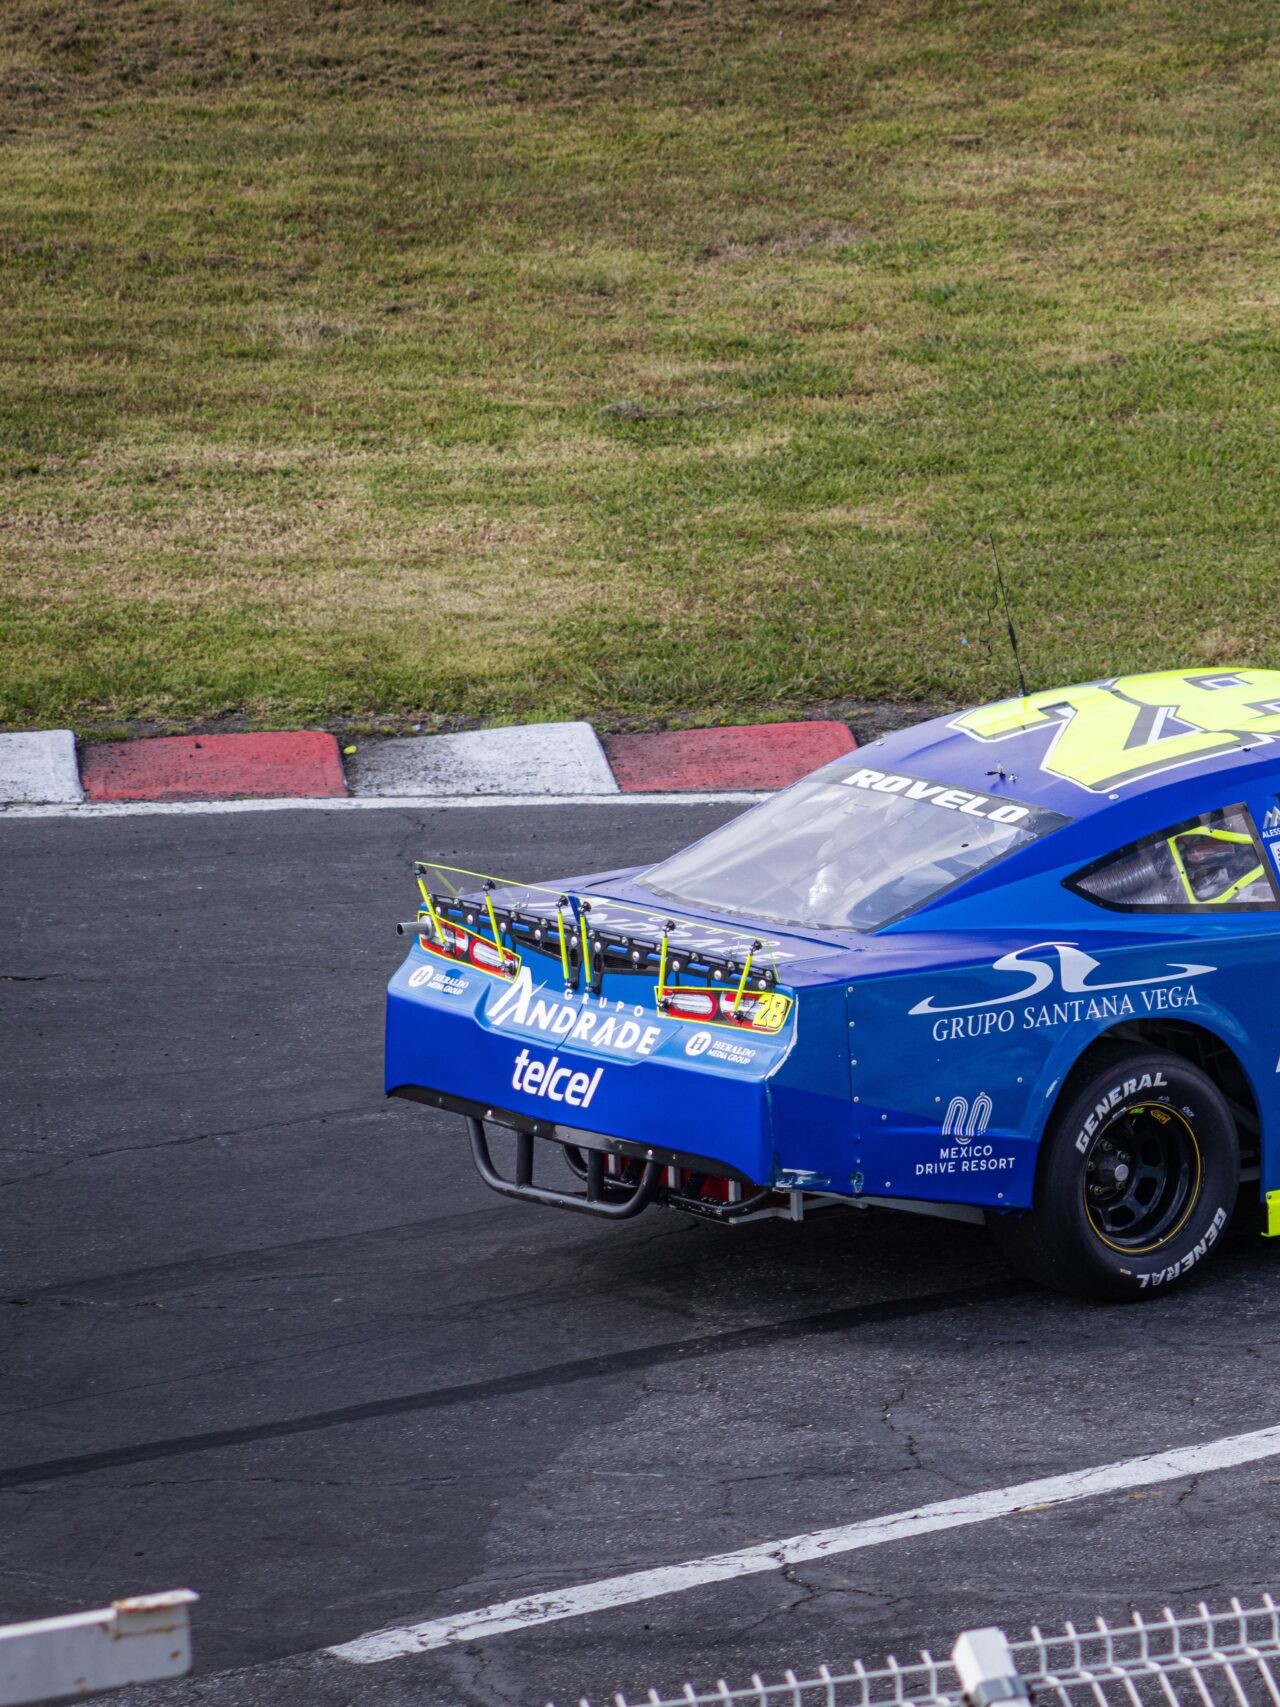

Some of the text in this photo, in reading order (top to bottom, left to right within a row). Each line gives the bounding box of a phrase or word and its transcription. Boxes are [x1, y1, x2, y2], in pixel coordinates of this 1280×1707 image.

[841, 768, 1030, 823] ROVELO
[432, 973, 470, 989] HERALDO
[486, 965, 661, 1055] ANDRADE
[564, 988, 644, 1018] GRUPO
[752, 994, 787, 1029] 28
[932, 984, 1200, 1042] GRUPO SANTANA VEGA
[706, 1048, 751, 1065] MEDIA GROUP
[712, 1040, 757, 1058] HERALDO
[512, 1048, 604, 1108] telcel
[1075, 1072, 1168, 1154] GENERAL
[915, 1157, 1016, 1176] DRIVE RESORT
[940, 1145, 993, 1160] MEXICO
[1136, 1207, 1228, 1288] GENERAL
